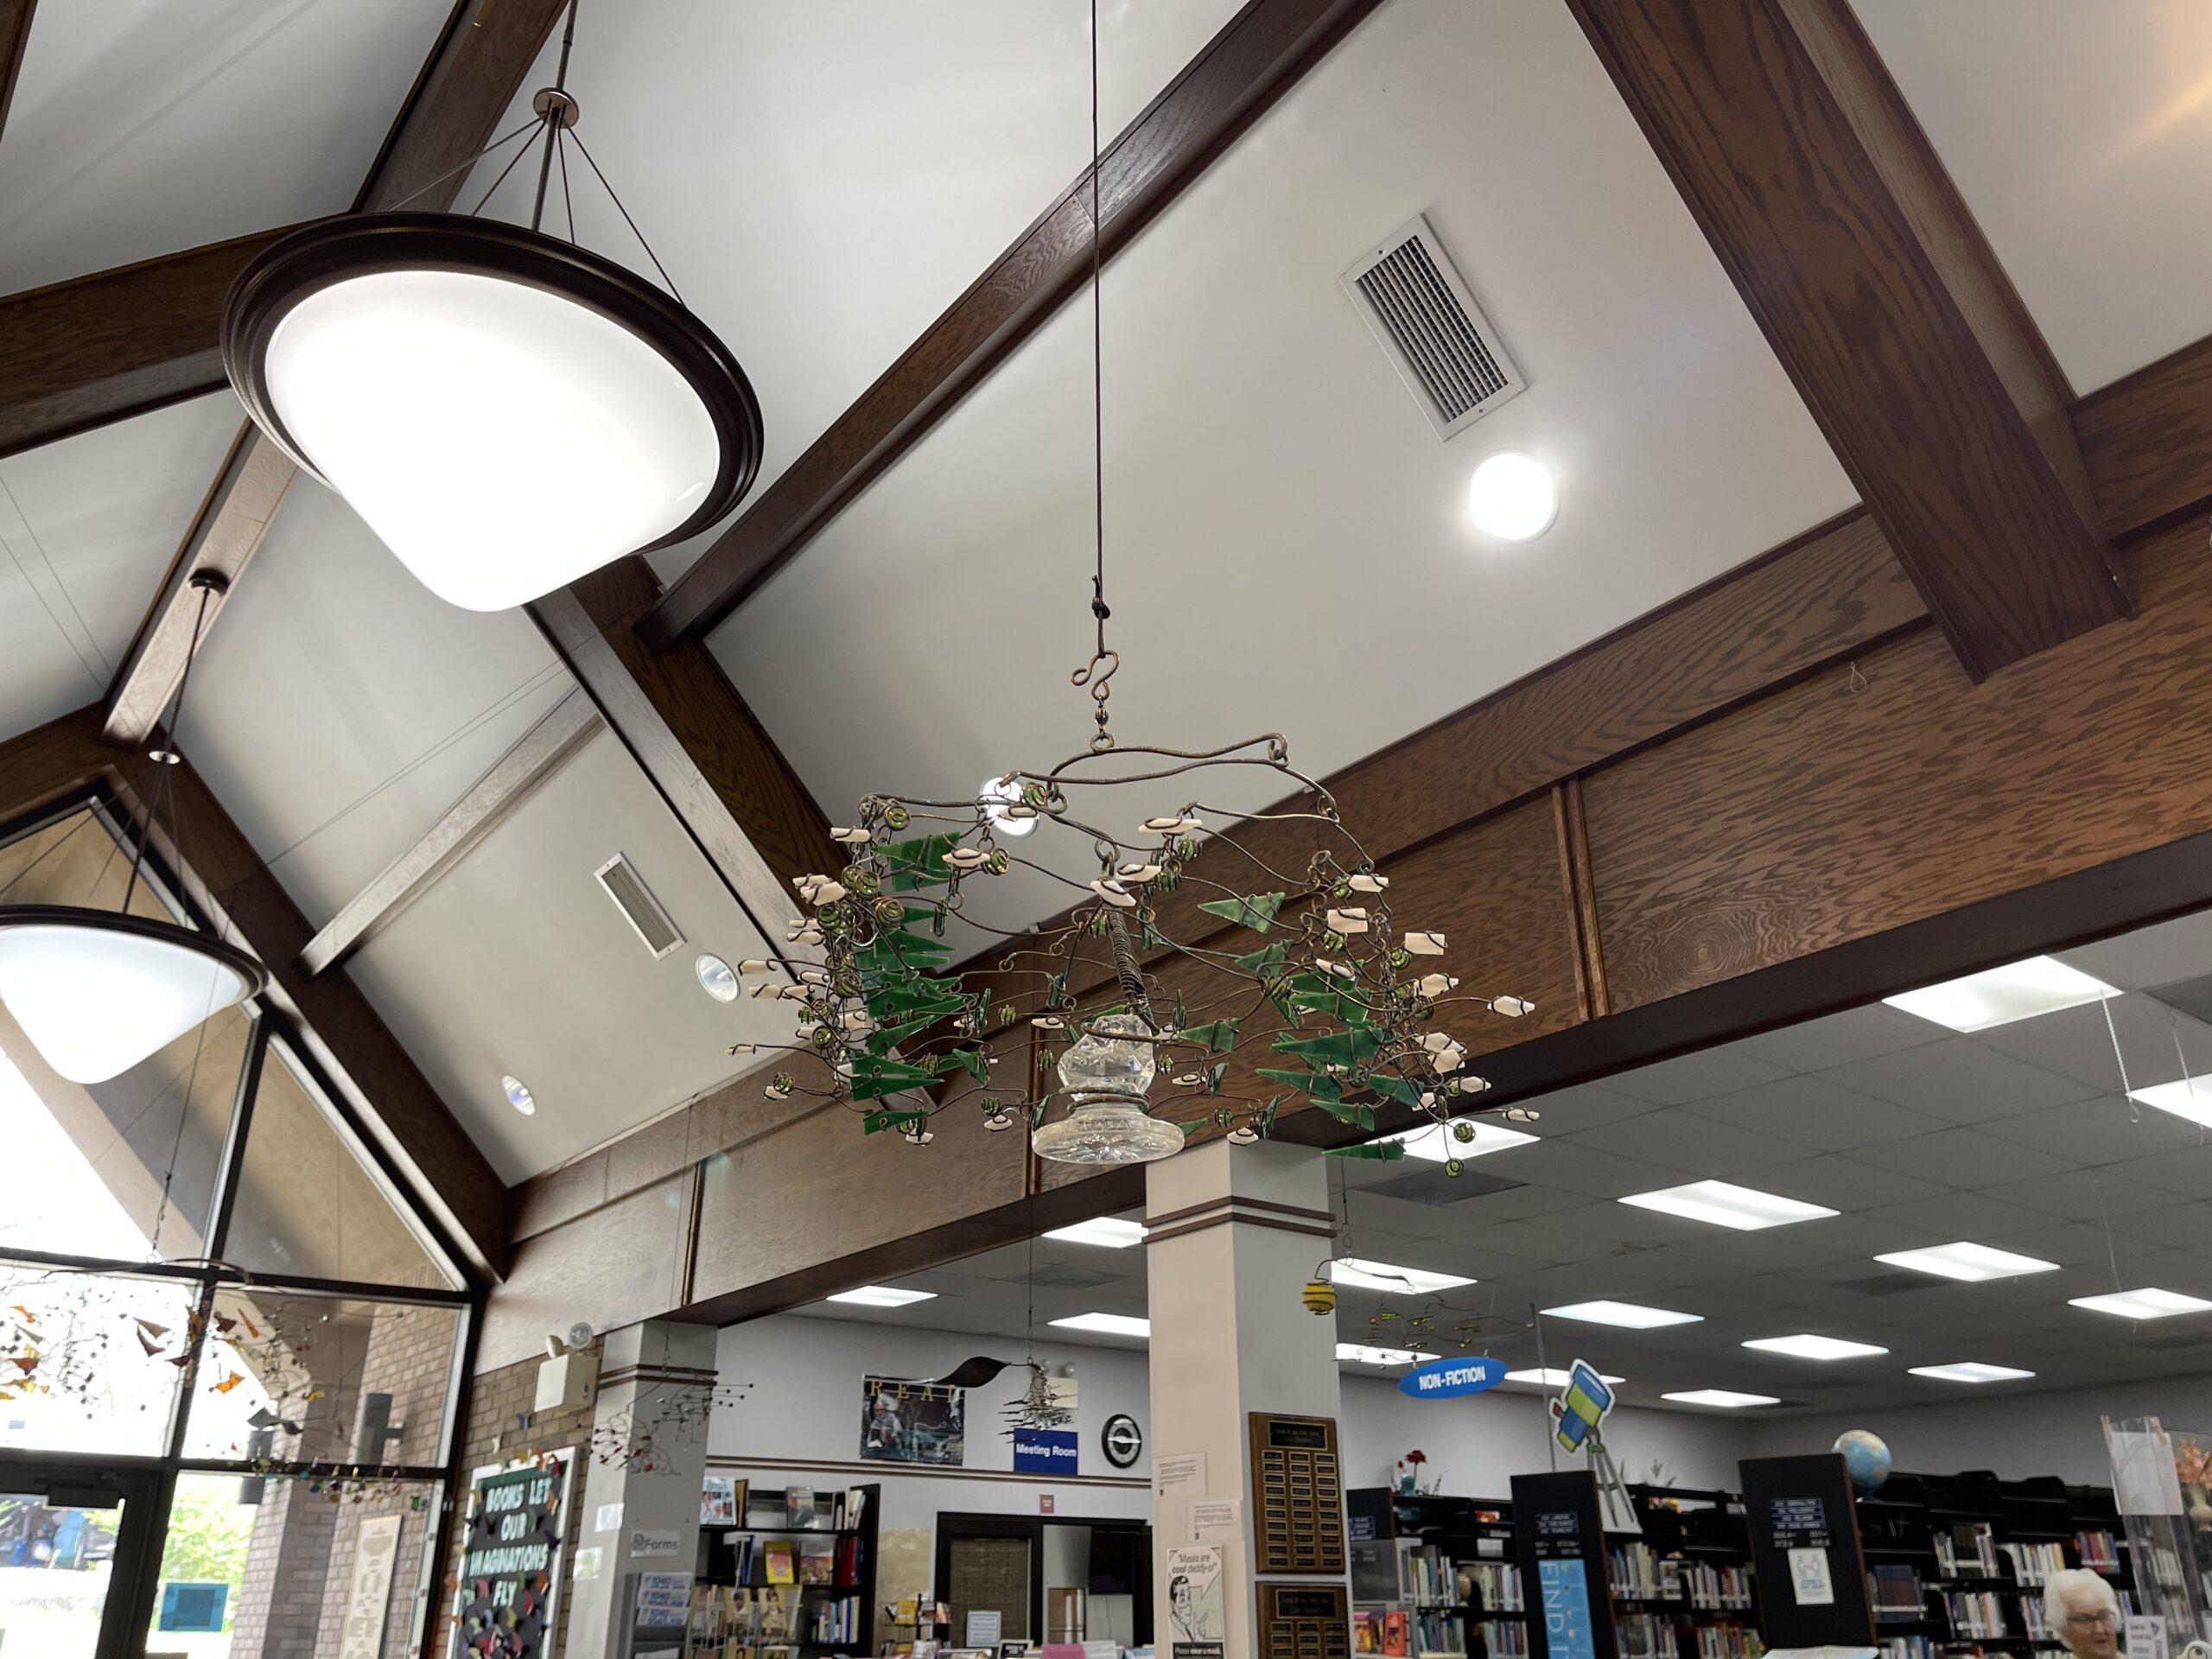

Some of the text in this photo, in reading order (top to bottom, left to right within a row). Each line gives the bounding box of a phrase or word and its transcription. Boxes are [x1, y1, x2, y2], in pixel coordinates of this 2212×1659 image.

[1418, 1365, 1486, 1390] NON-FICTION
[1016, 1443, 1077, 1458] Meeting Room
[485, 1477, 553, 1513] BOOKS LET
[500, 1512, 528, 1541] OUR
[468, 1543, 549, 1577] IMAGINATIONS
[493, 1580, 518, 1608] FLY
[1540, 1561, 1566, 1633] FIND
